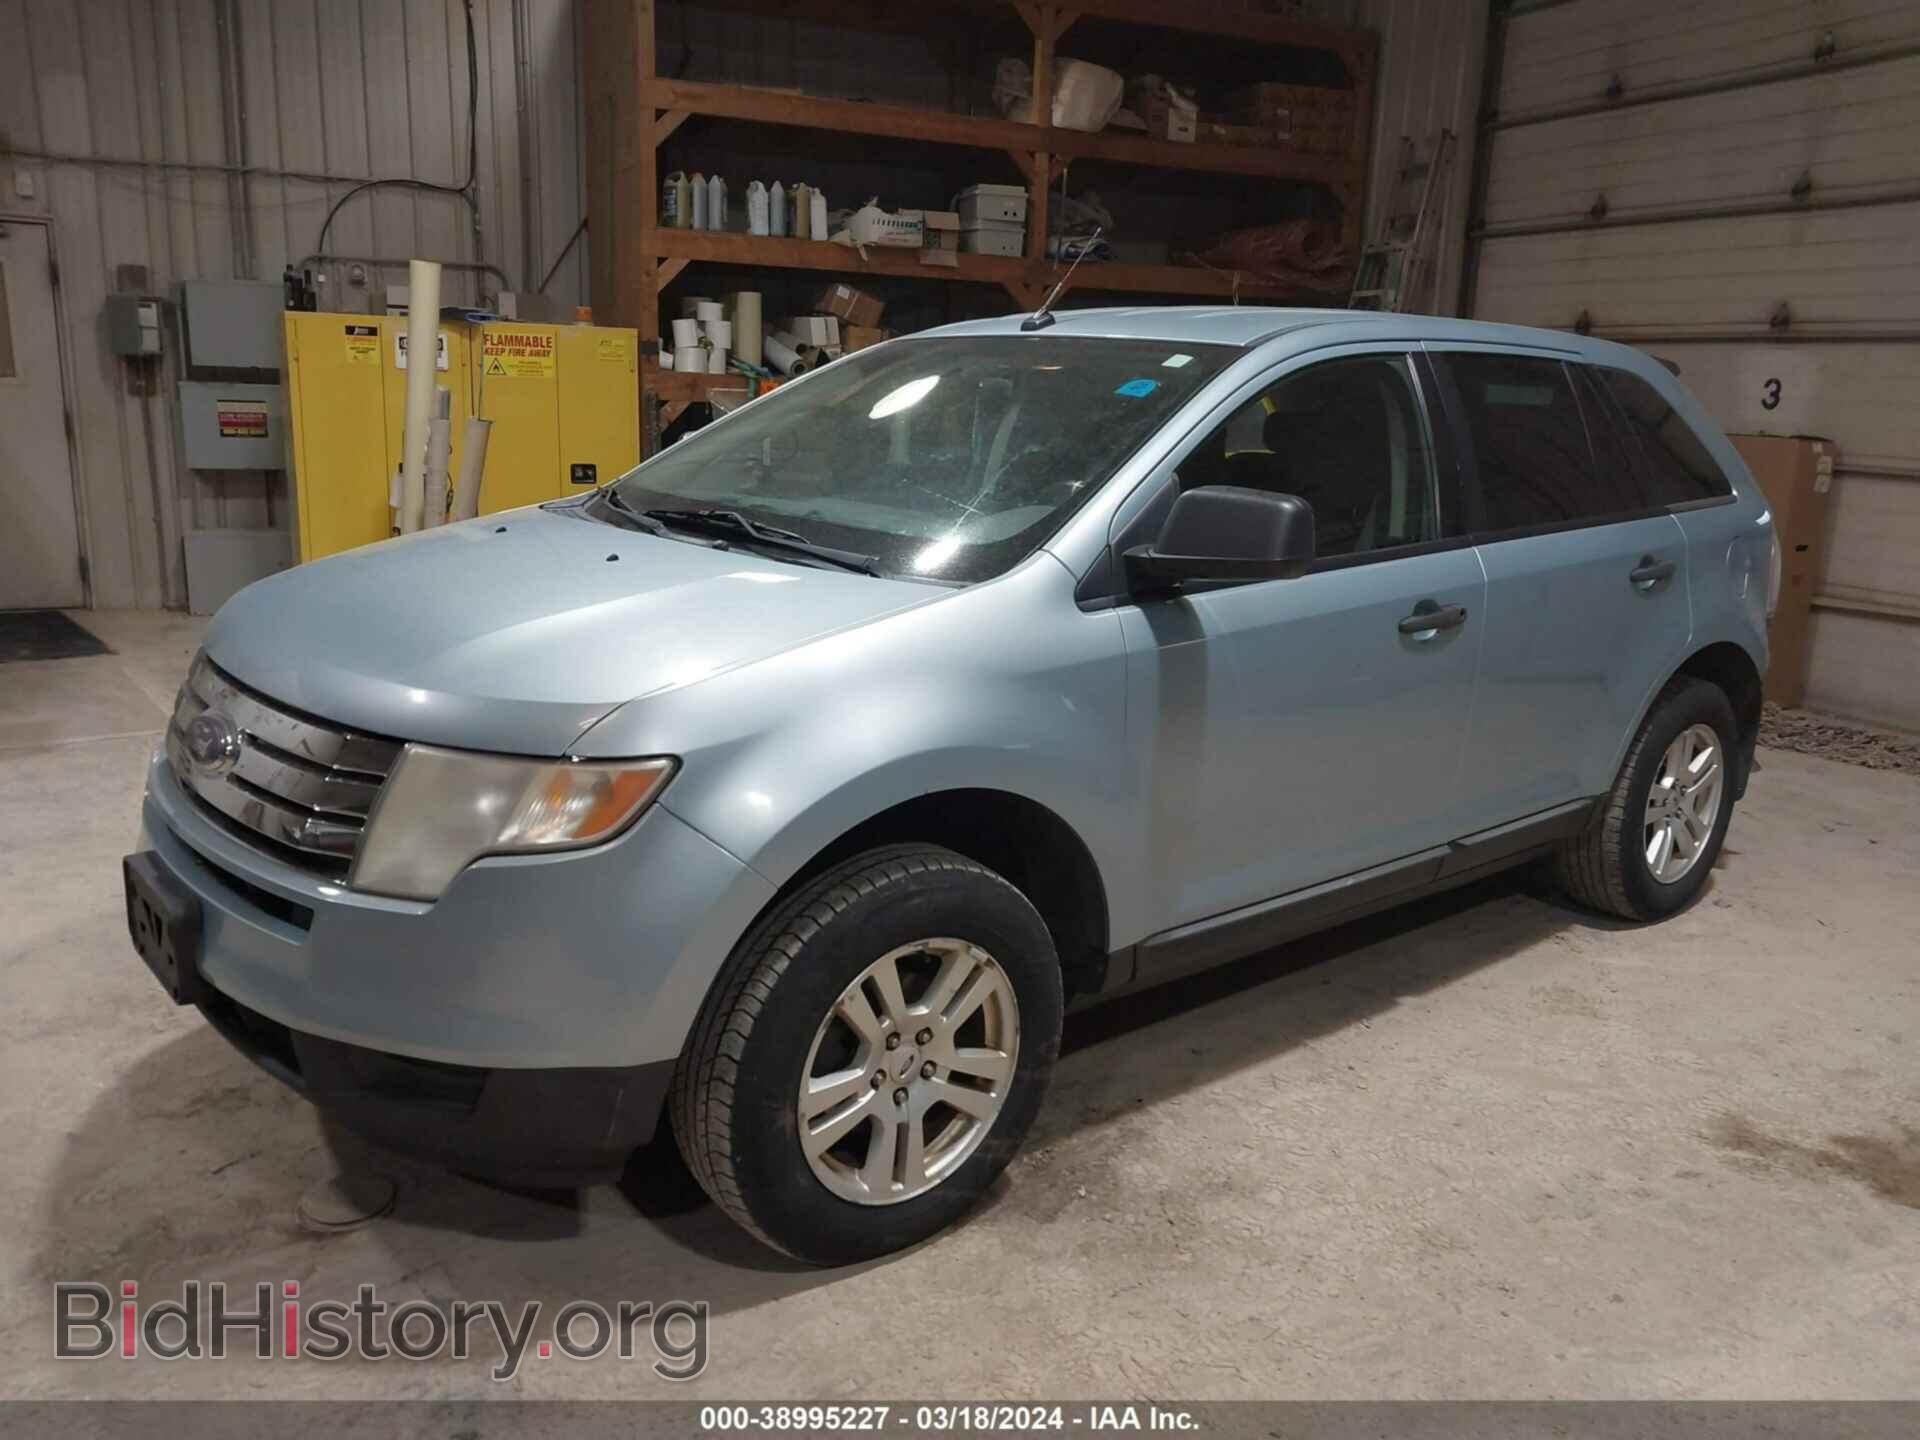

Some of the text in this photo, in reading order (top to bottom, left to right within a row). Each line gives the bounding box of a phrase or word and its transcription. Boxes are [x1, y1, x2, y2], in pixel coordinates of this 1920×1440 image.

[484, 333, 553, 349] FLAMMABLE
[484, 347, 552, 358] KEEP FIRE AWAY
[1761, 378, 1782, 410] 3
